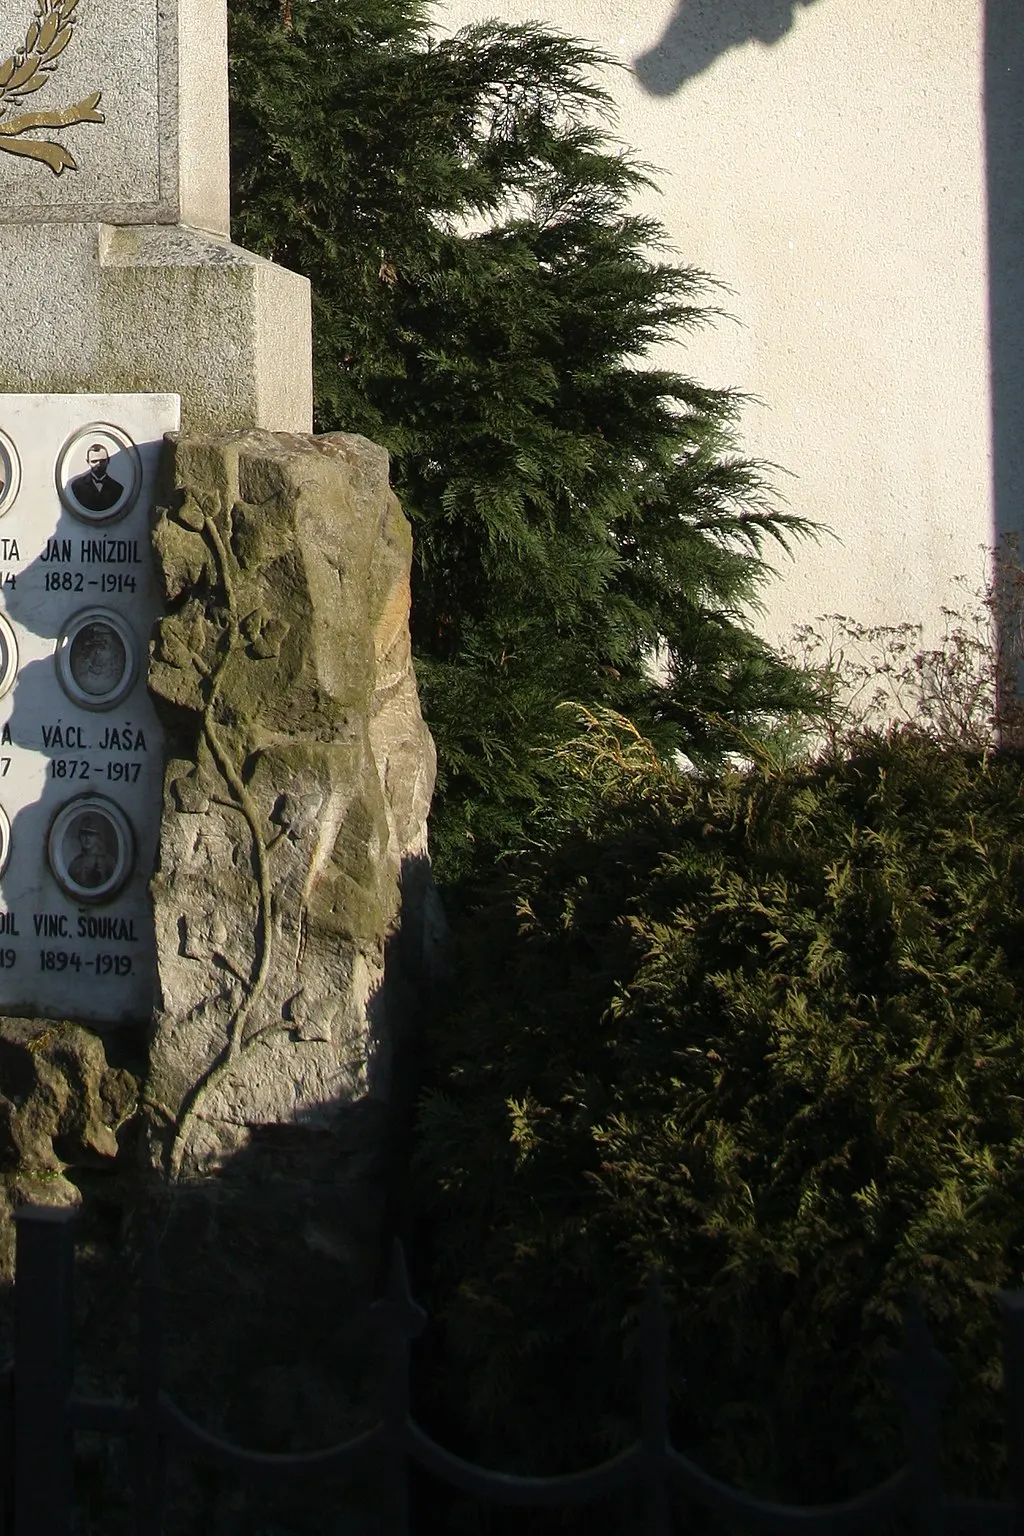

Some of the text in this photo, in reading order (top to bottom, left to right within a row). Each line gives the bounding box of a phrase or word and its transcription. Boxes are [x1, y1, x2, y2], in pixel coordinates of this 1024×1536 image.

[40, 534, 142, 563] JAN HNÍZDIL
[42, 719, 147, 752] VÁCL. JAŠA
[34, 908, 138, 941] VINC. ŠOUKAL
